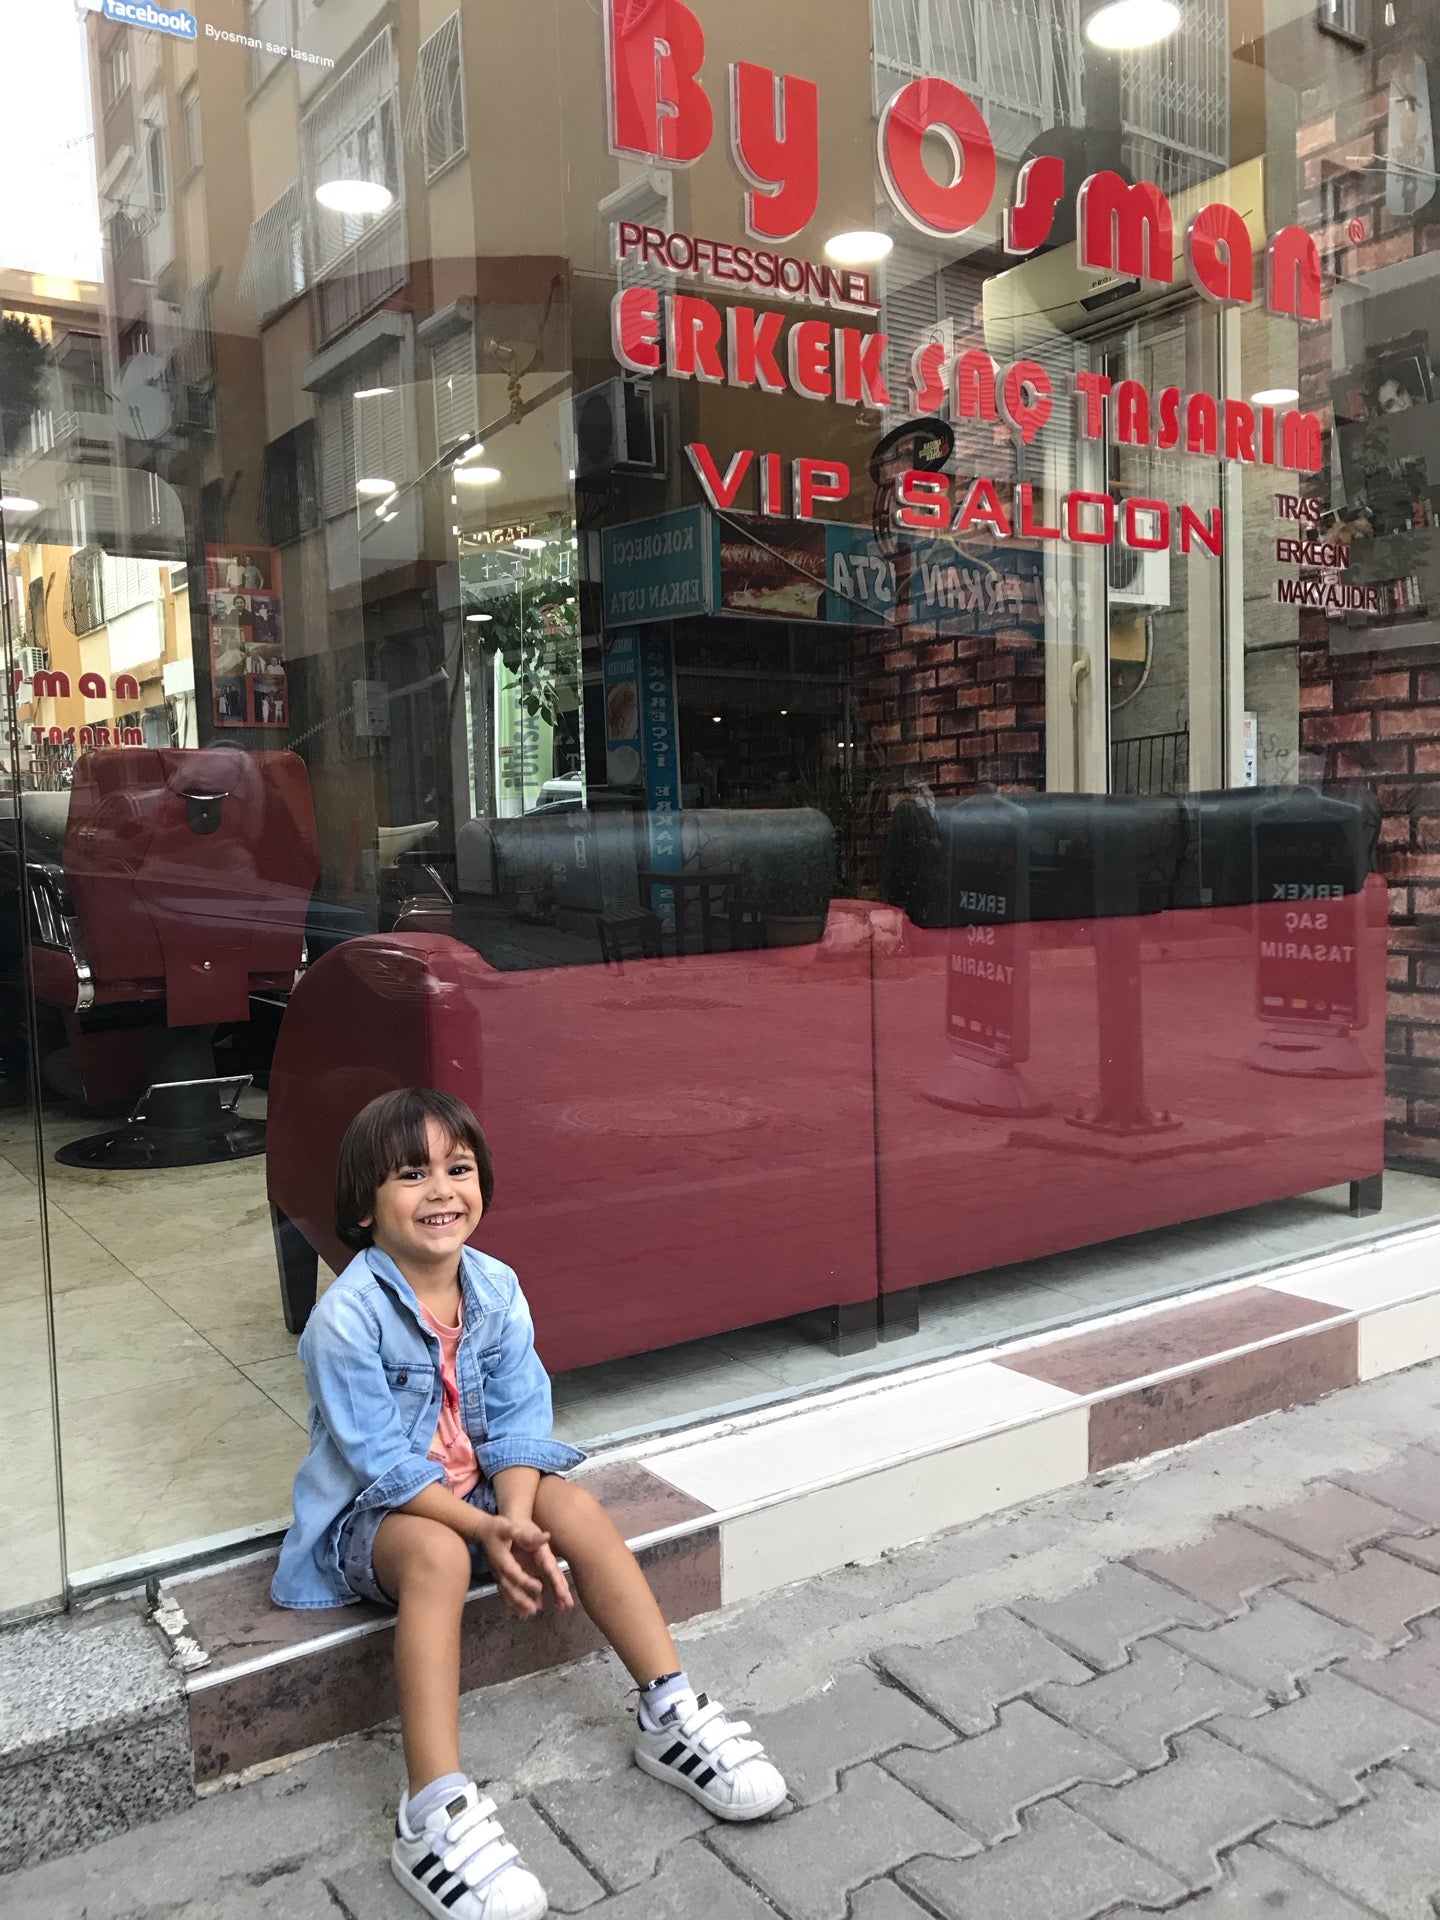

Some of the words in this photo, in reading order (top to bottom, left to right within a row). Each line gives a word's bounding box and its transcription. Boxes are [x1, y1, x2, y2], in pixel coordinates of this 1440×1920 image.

[107, 0, 192, 33] facebook
[205, 24, 262, 49] Byosman
[604, 0, 819, 244] By
[877, 77, 1321, 321] Osman
[613, 221, 882, 312] PROFESSIONNEL
[611, 286, 892, 410] ERKEK
[908, 342, 1054, 445] SAÇ
[1072, 371, 1322, 474] TASARIM
[684, 442, 850, 520] VIP
[896, 469, 1222, 558] SALOON
[31, 725, 143, 746] TASARIM
